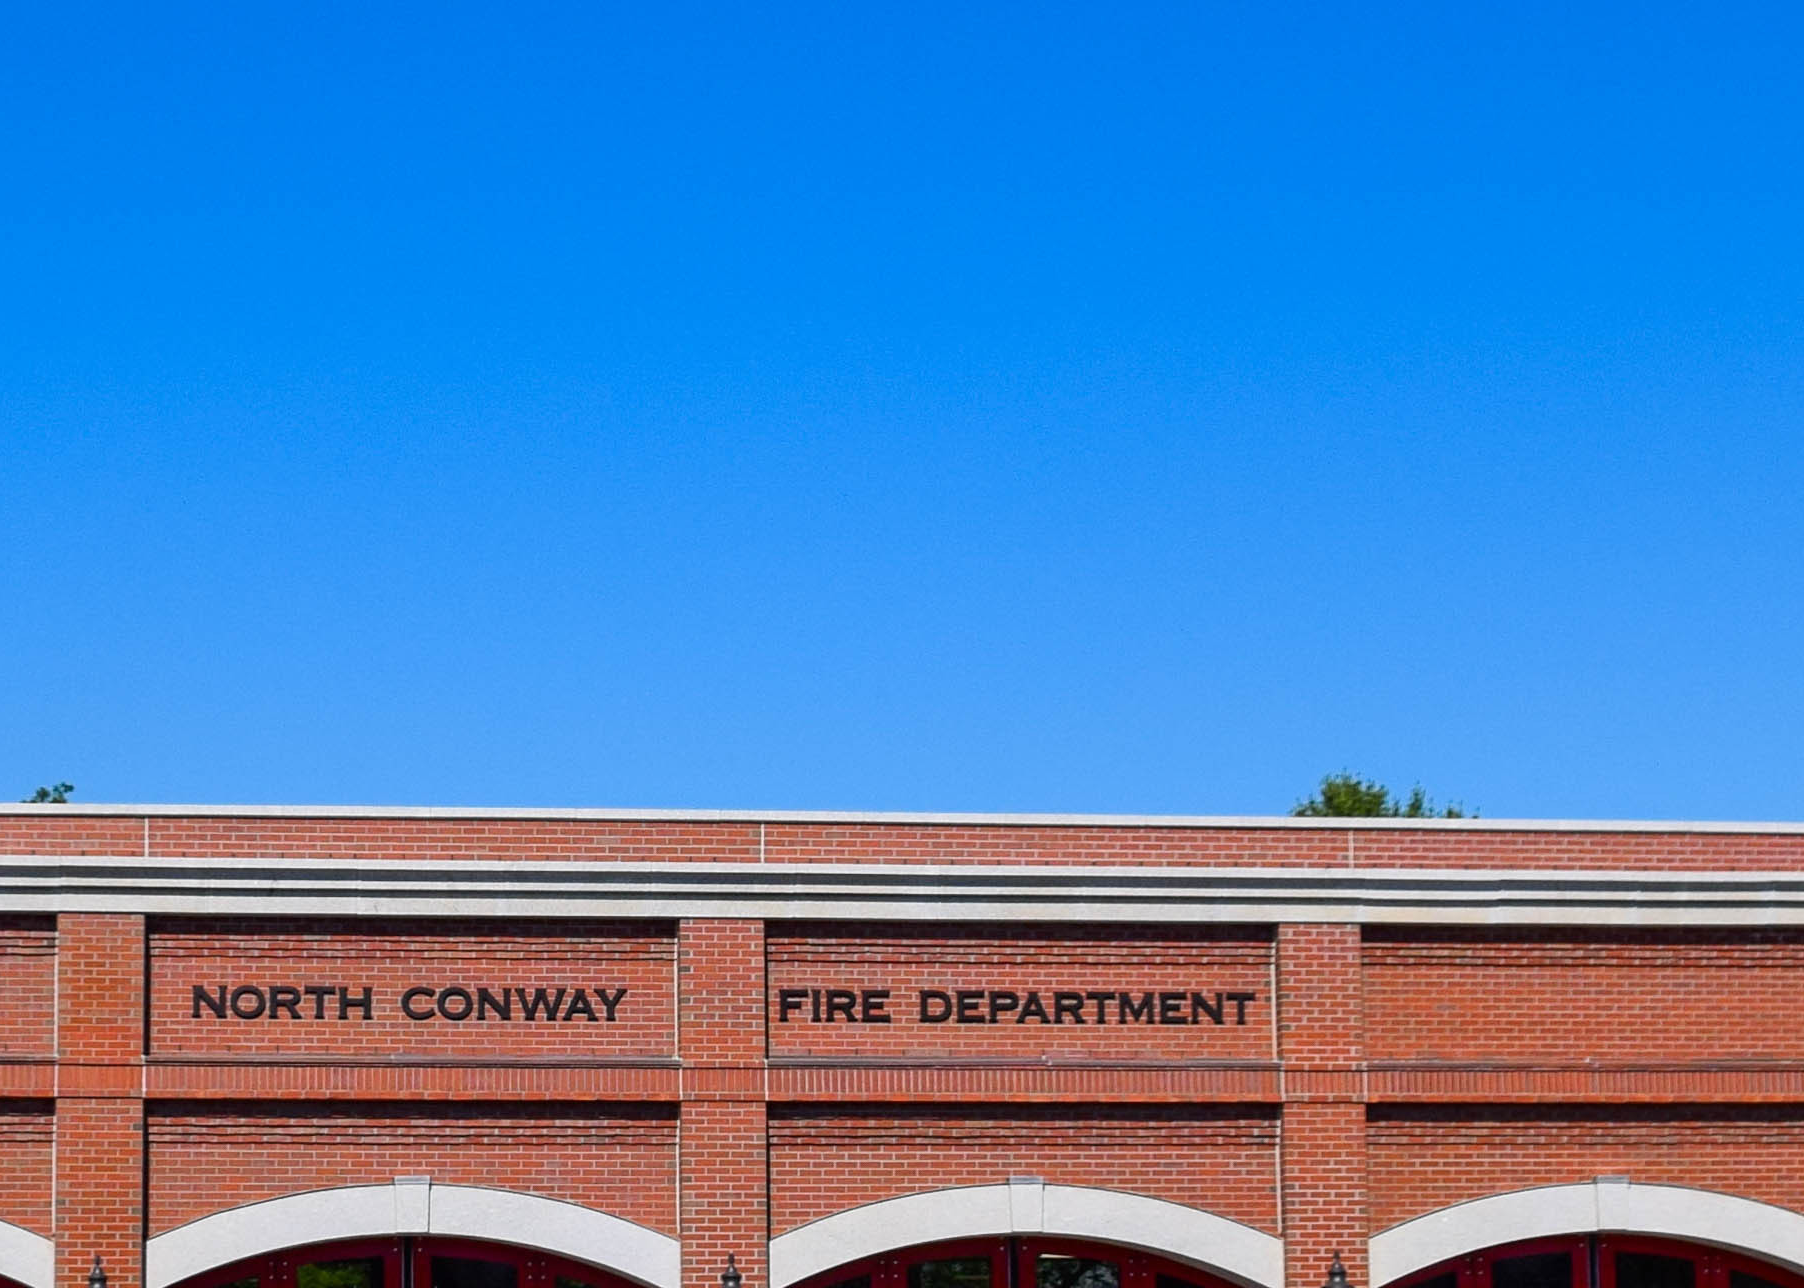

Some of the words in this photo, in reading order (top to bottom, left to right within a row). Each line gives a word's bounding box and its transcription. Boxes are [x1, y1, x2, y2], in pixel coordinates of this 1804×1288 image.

[192, 985, 373, 1020] NORTH
[401, 987, 627, 1022] CONWAY
[778, 988, 891, 1023] FIRE
[918, 990, 1256, 1025] DEPARTMENT
